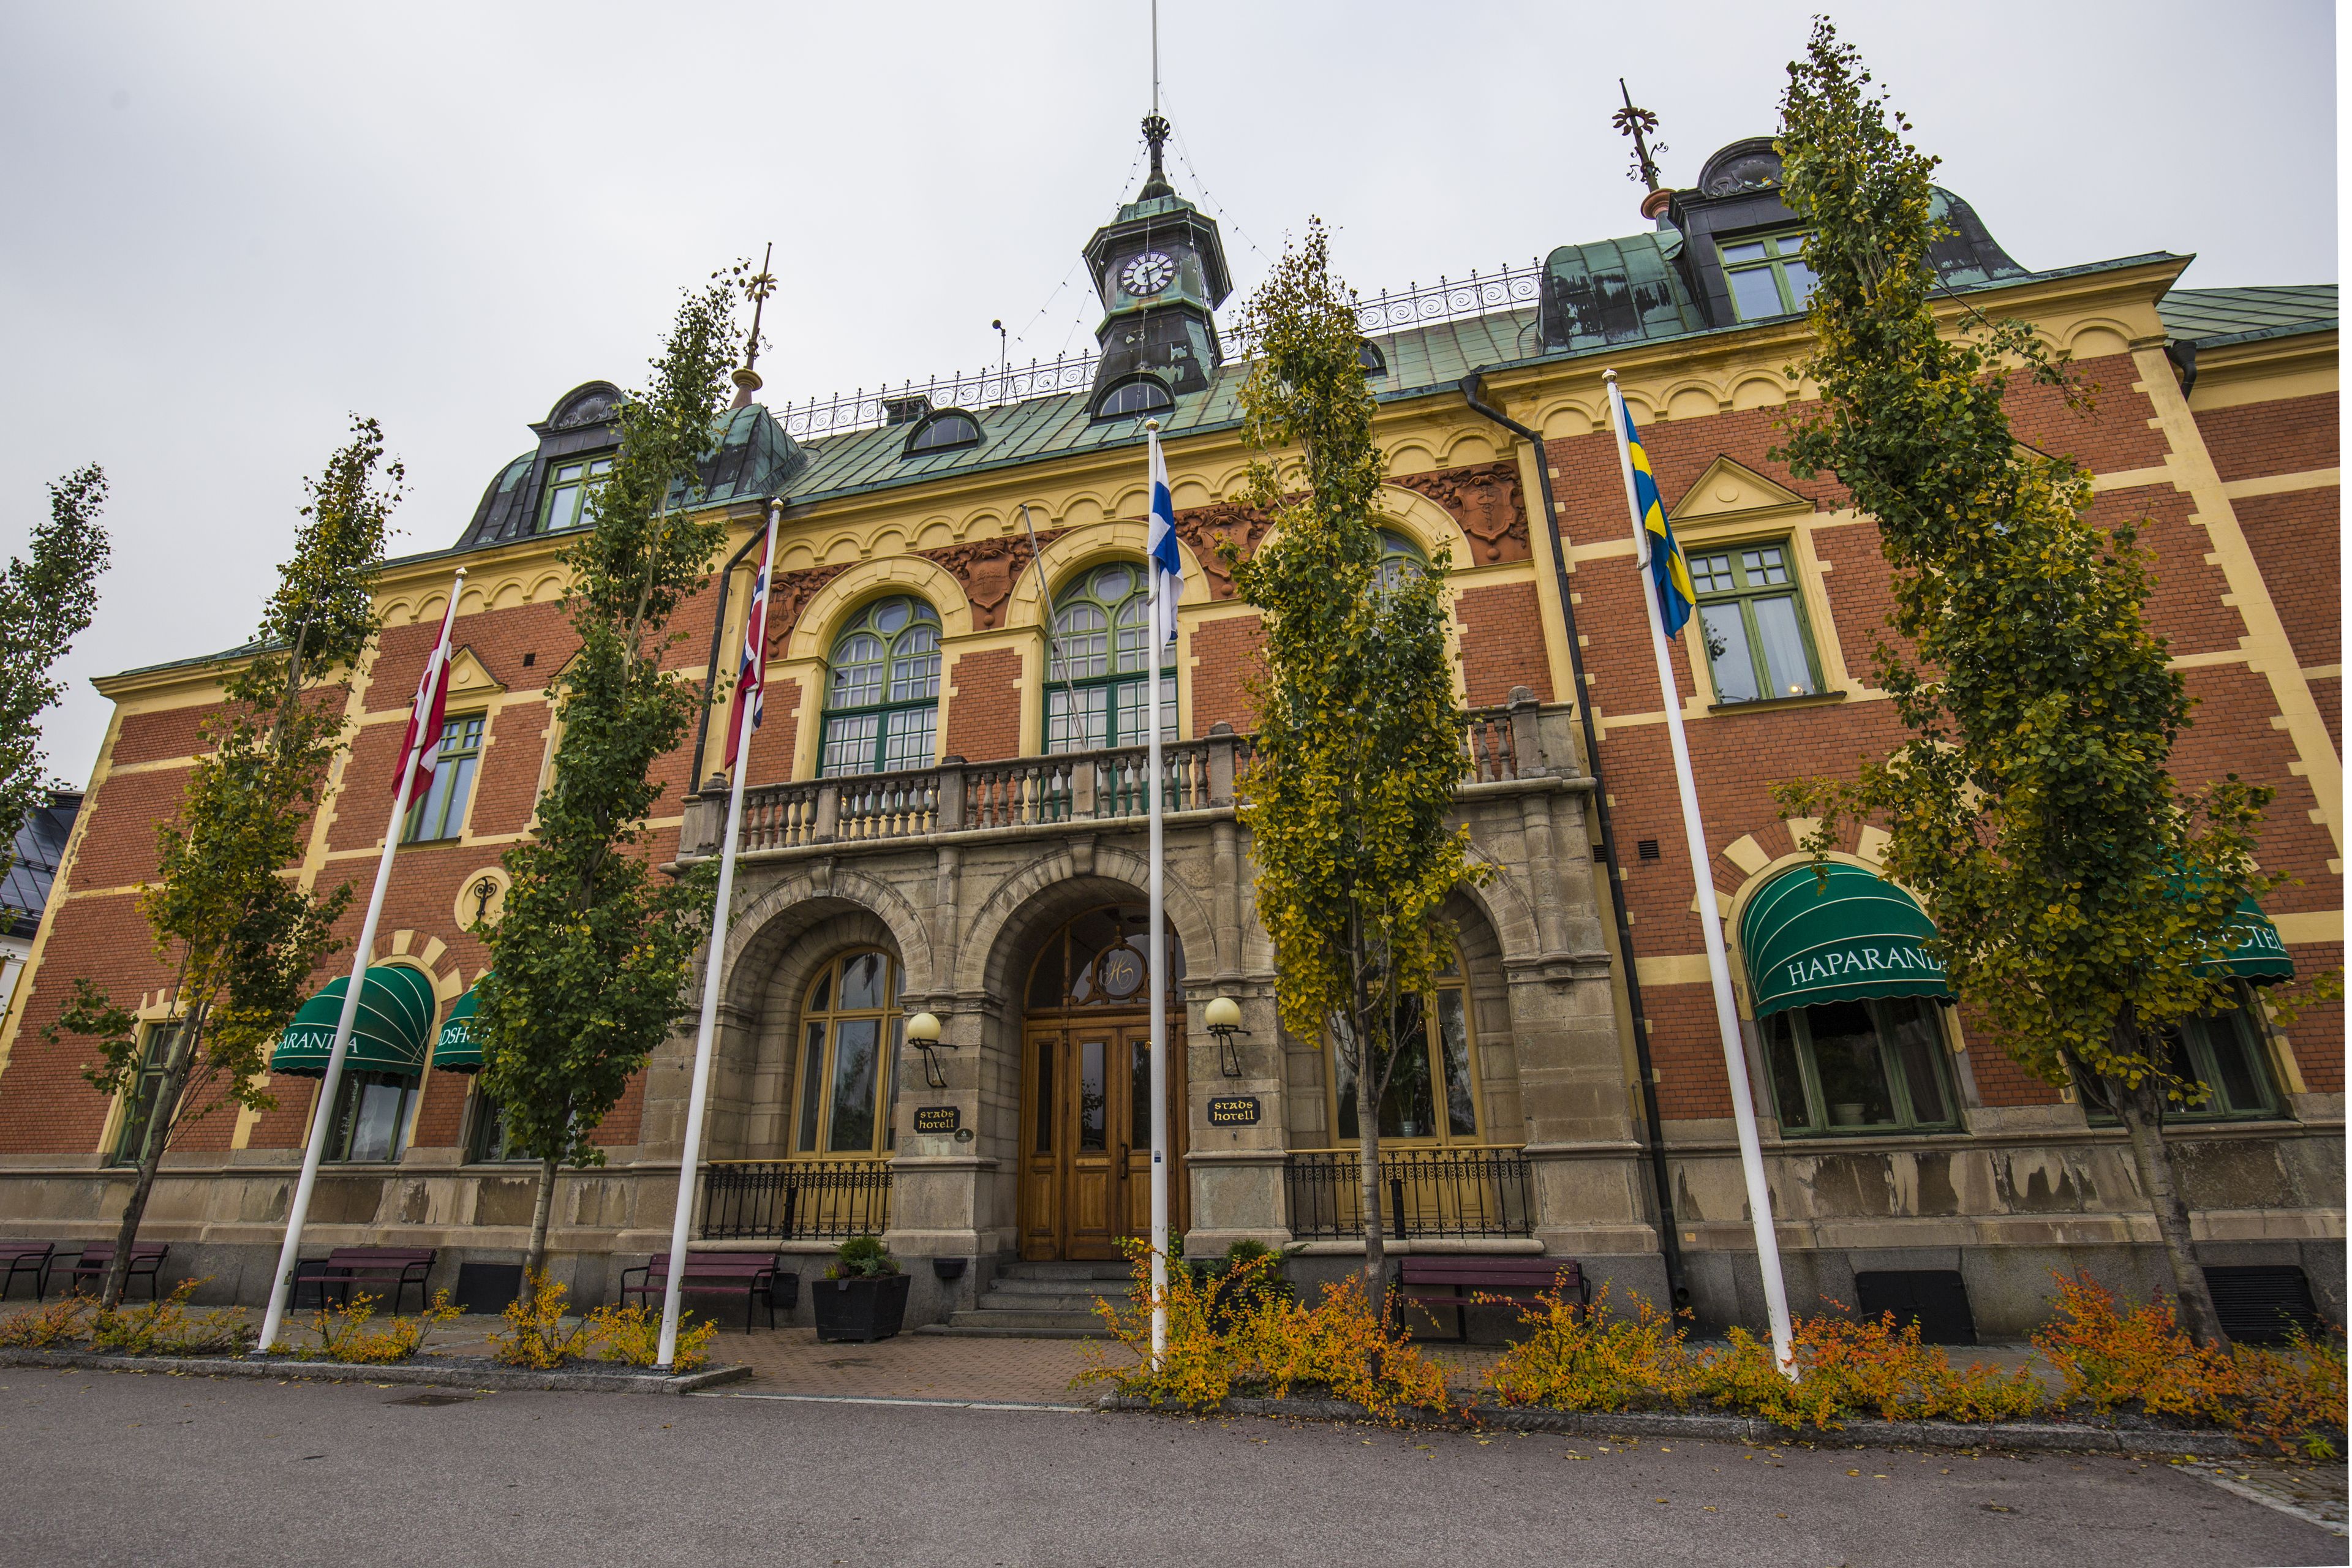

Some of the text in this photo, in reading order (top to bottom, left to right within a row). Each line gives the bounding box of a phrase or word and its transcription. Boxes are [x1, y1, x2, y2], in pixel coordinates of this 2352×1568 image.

[1787, 947, 1947, 986] HAPARAND
[1214, 1110, 1255, 1121] hotell
[919, 1118, 955, 1129] hotell
